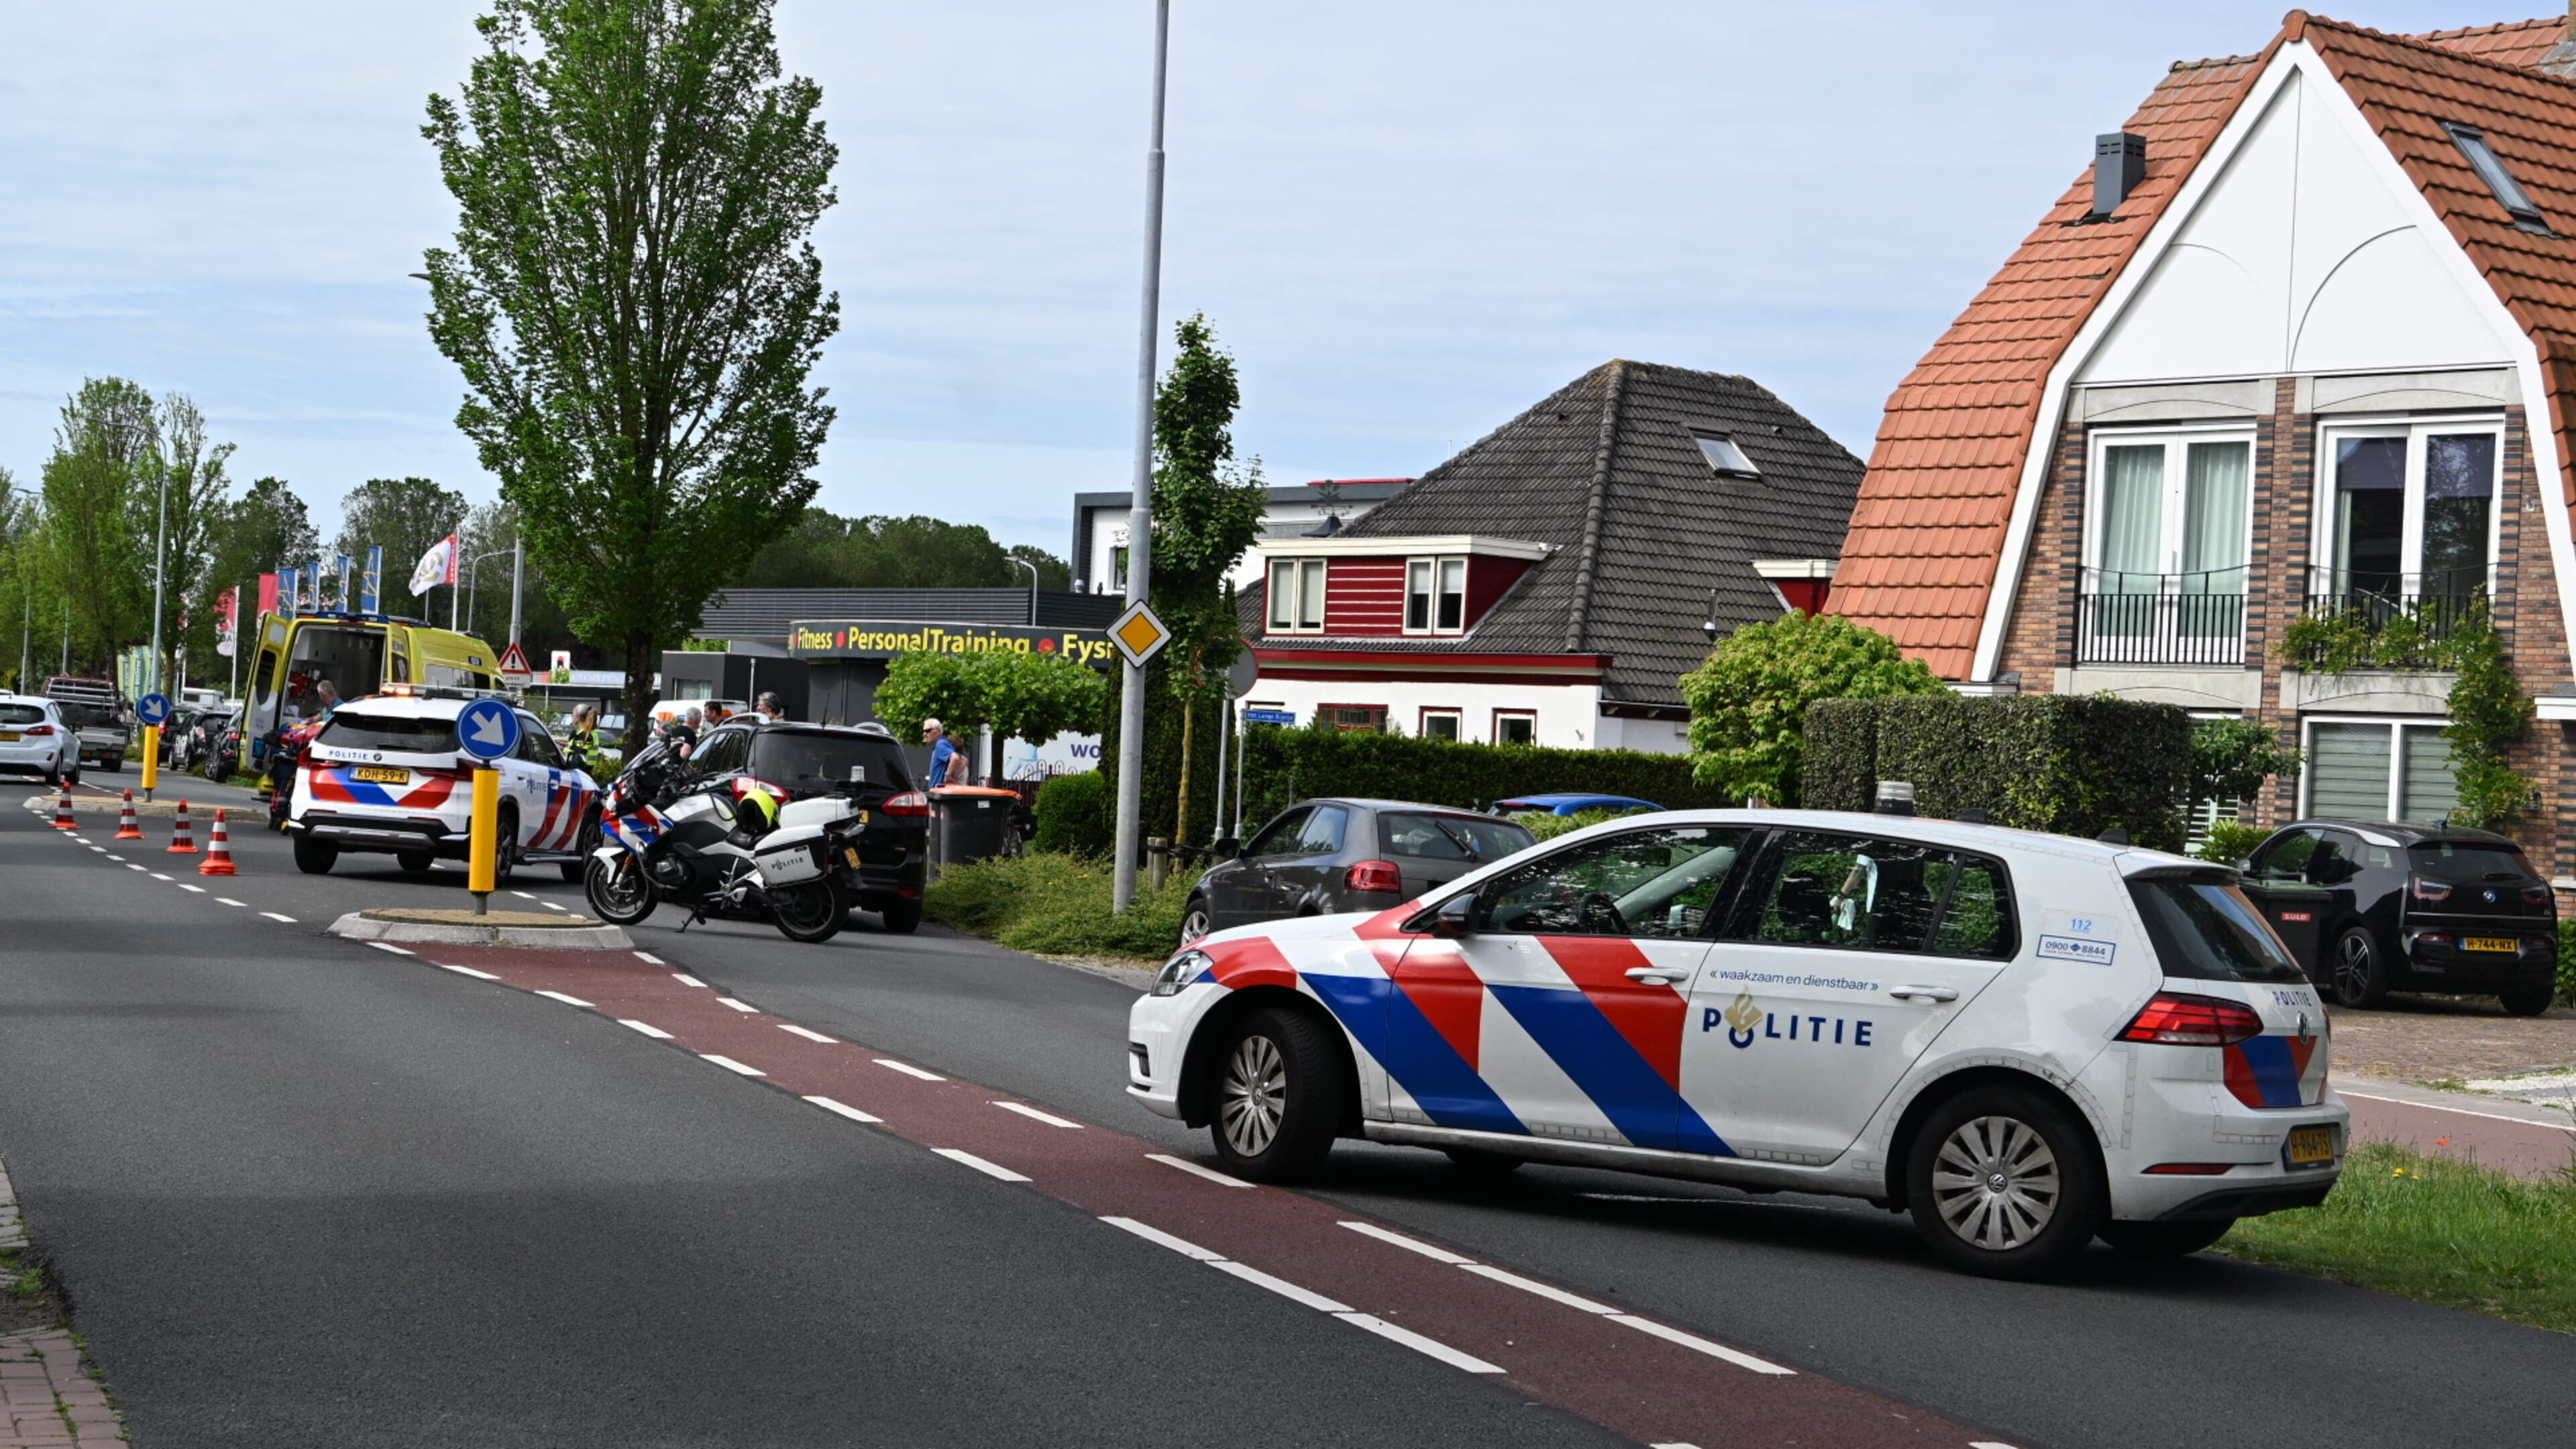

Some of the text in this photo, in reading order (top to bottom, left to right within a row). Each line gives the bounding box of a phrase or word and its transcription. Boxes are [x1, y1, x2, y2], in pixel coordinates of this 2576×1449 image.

[798, 627, 833, 649] Fitness
[849, 626, 1030, 659] PersonalTraining
[329, 751, 368, 760] POLITIE
[356, 769, 405, 781] KDH-59-K
[771, 857, 804, 870] POLITIE
[2071, 918, 2092, 930] 112
[2045, 941, 2068, 951] 0900
[2082, 945, 2106, 955] 8844
[2467, 939, 2512, 950] H-744-NX
[1720, 970, 1784, 983] waakzaam
[1786, 975, 1801, 985] en
[1803, 975, 1869, 991] dienstbaar
[2272, 991, 2312, 1007] POLITIE
[1703, 1007, 1873, 1049] POLITIE
